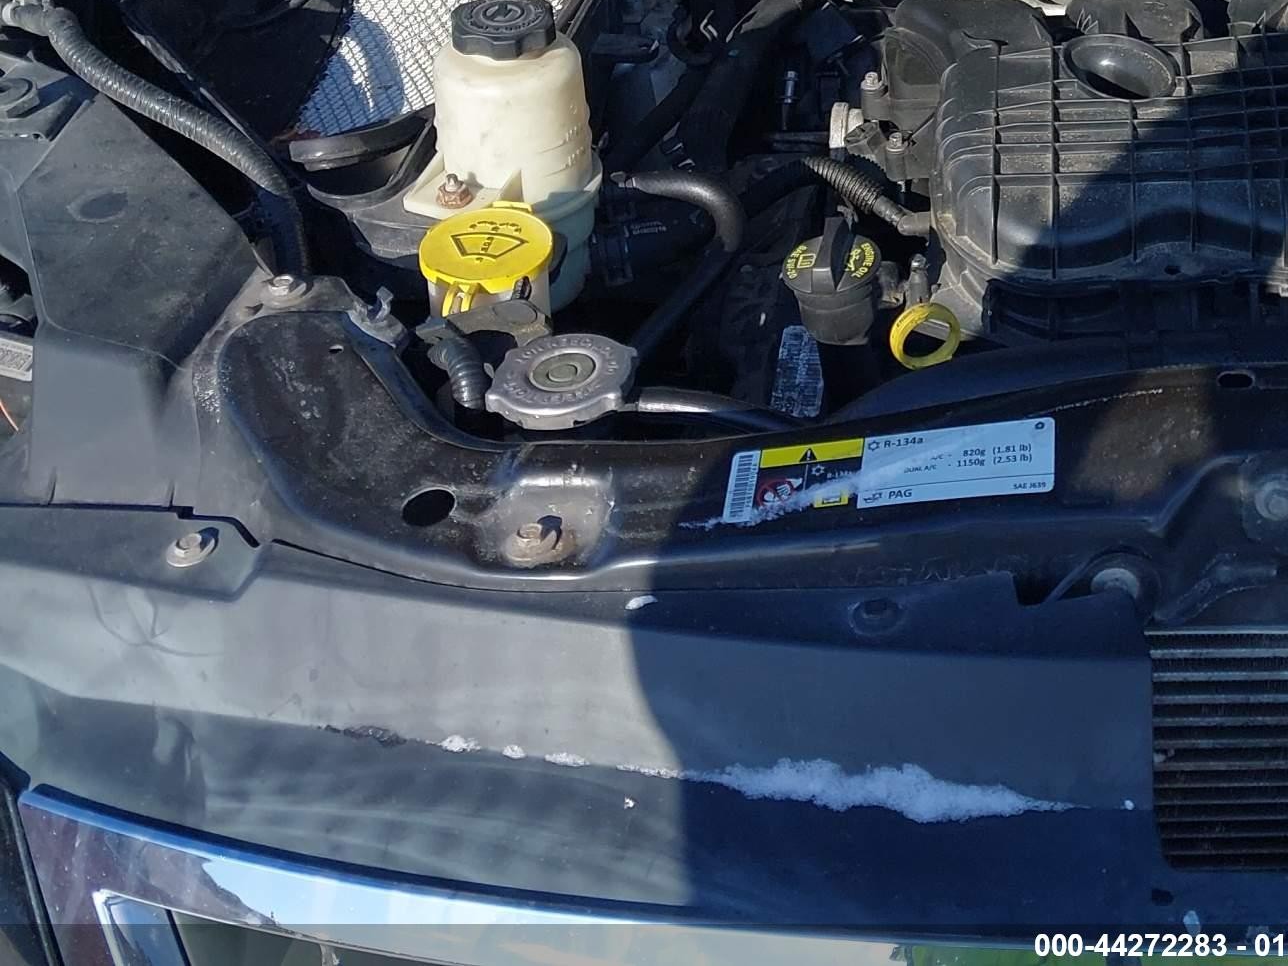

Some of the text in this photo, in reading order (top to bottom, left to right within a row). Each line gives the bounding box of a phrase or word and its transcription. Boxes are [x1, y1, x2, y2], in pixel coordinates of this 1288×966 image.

[850, 242, 875, 279] ENGINE OIL
[883, 435, 924, 448] R-134a
[962, 446, 986, 459] 820g
[992, 444, 1018, 456] (1.81
[1019, 443, 1032, 455] lb)
[956, 457, 986, 469] 1150g
[992, 454, 1018, 466] (2.53
[1019, 452, 1033, 464] lb)
[1013, 482, 1028, 491] SAE
[888, 488, 913, 500] PAG
